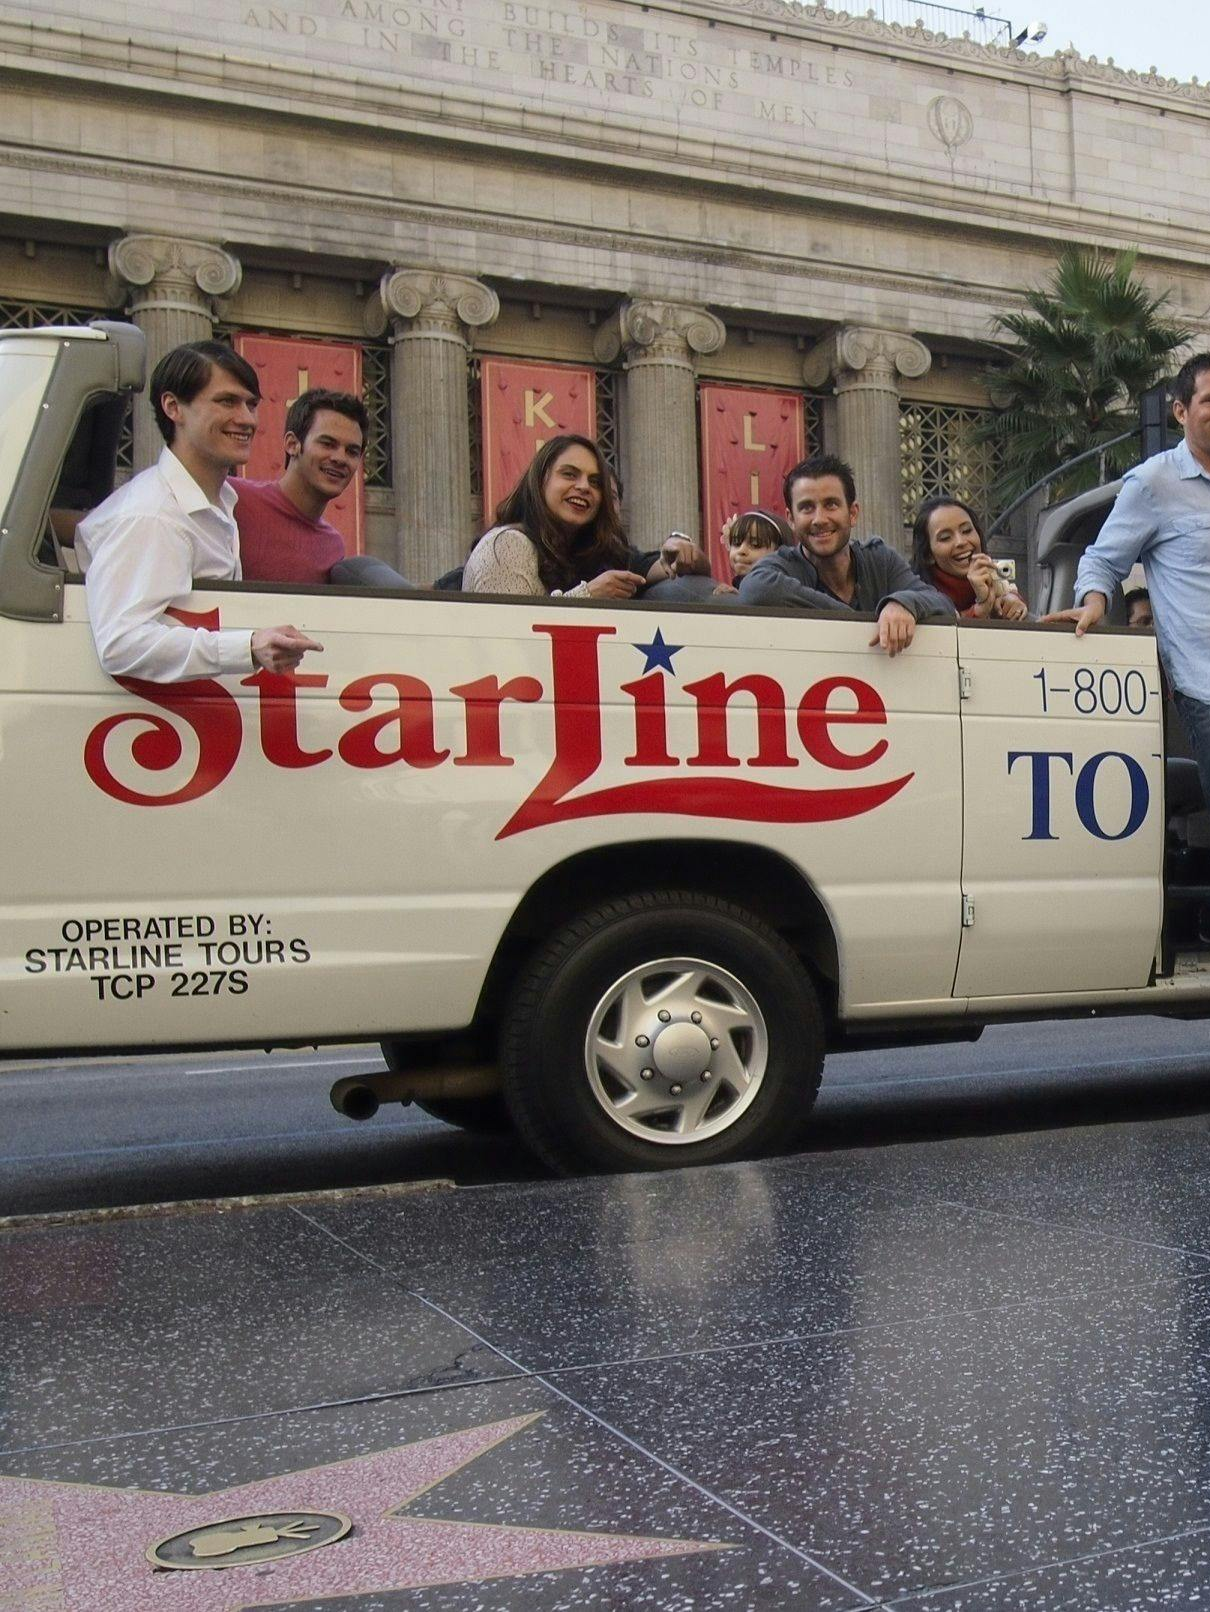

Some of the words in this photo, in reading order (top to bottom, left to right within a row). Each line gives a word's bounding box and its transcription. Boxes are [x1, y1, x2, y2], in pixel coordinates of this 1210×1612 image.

[244, 9, 318, 36] AND
[362, 28, 399, 52] IN
[438, 41, 501, 69] THE
[539, 60, 654, 98] HEARTS
[690, 89, 724, 111] OF
[757, 100, 819, 128] MEN
[341, 0, 465, 37] AMONG
[502, 28, 564, 56] THE
[601, 46, 739, 89] NATIONS
[504, 2, 618, 41] BUILDS
[654, 32, 698, 57] ITS
[727, 48, 855, 88] TEMPLES
[84, 606, 915, 841] StarLine
[1033, 667, 1159, 716] 1-800-
[1008, 751, 1161, 841] TO
[25, 944, 184, 974] STARLINE
[198, 938, 311, 967] TOURS
[61, 915, 215, 943] OPERATED
[229, 913, 272, 937] BY:
[90, 974, 156, 1001] TCP
[171, 969, 249, 998] 227S
